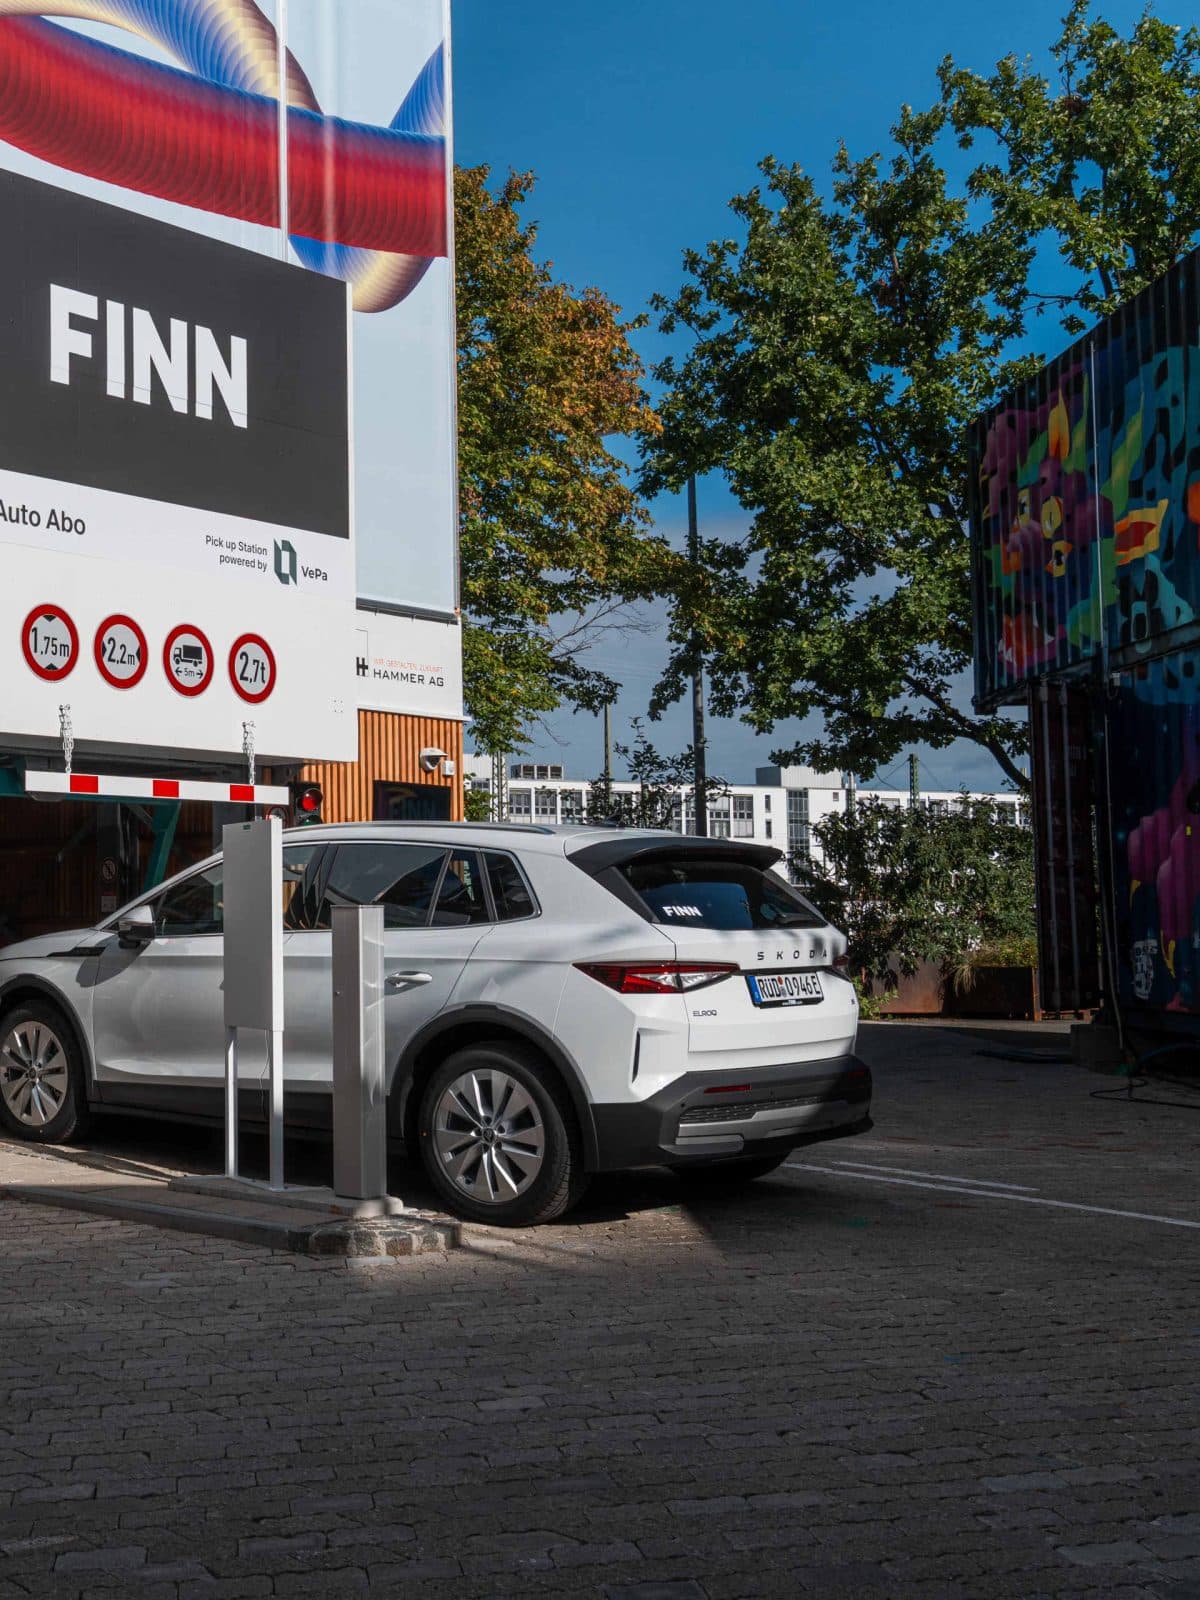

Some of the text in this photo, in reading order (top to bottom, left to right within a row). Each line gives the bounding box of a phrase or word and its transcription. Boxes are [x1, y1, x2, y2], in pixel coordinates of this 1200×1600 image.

[50, 283, 248, 429] FINN
[46, 509, 86, 535] Abo
[205, 535, 268, 556] Pick up Station
[219, 554, 268, 573] powered by
[301, 565, 328, 581] VePa
[373, 668, 444, 687] HAMMER AG
[662, 905, 704, 917] FINN
[692, 1009, 717, 1017] ELROQ
